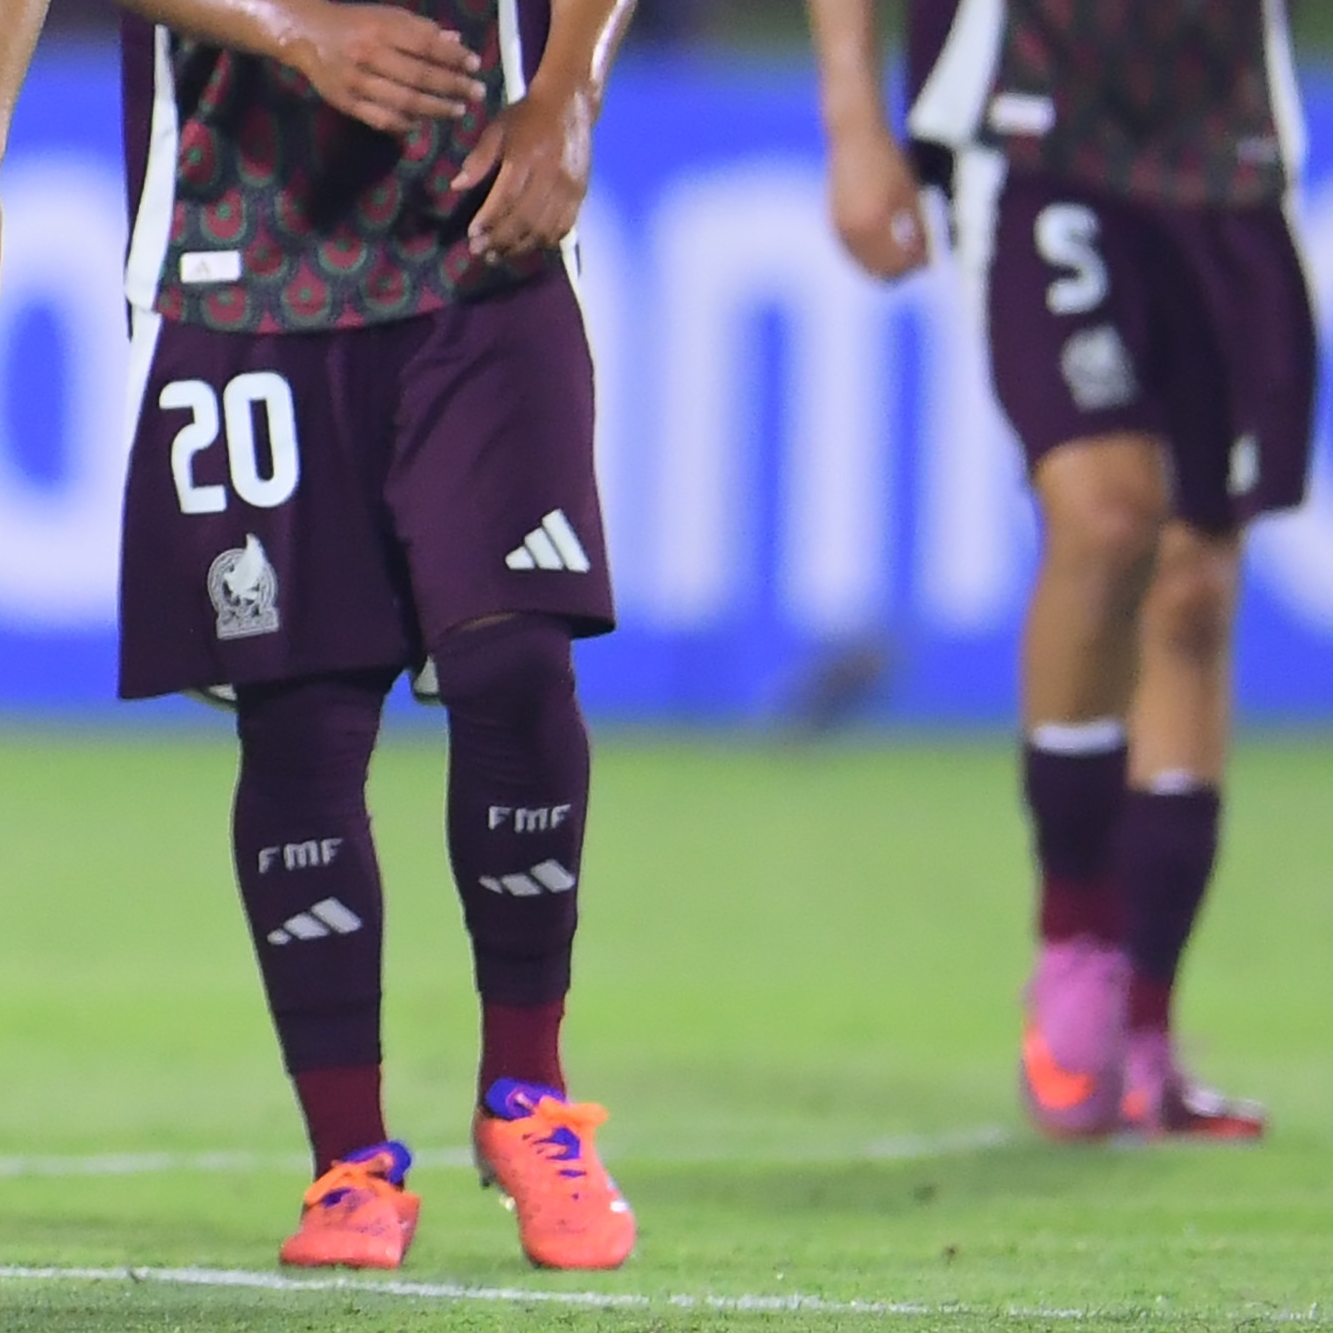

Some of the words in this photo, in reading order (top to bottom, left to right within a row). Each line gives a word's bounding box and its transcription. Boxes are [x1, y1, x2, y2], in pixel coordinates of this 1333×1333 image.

[1035, 201, 1109, 314] 5
[159, 371, 300, 514] 20
[258, 838, 343, 873] FMF
[488, 804, 571, 834] FMF
